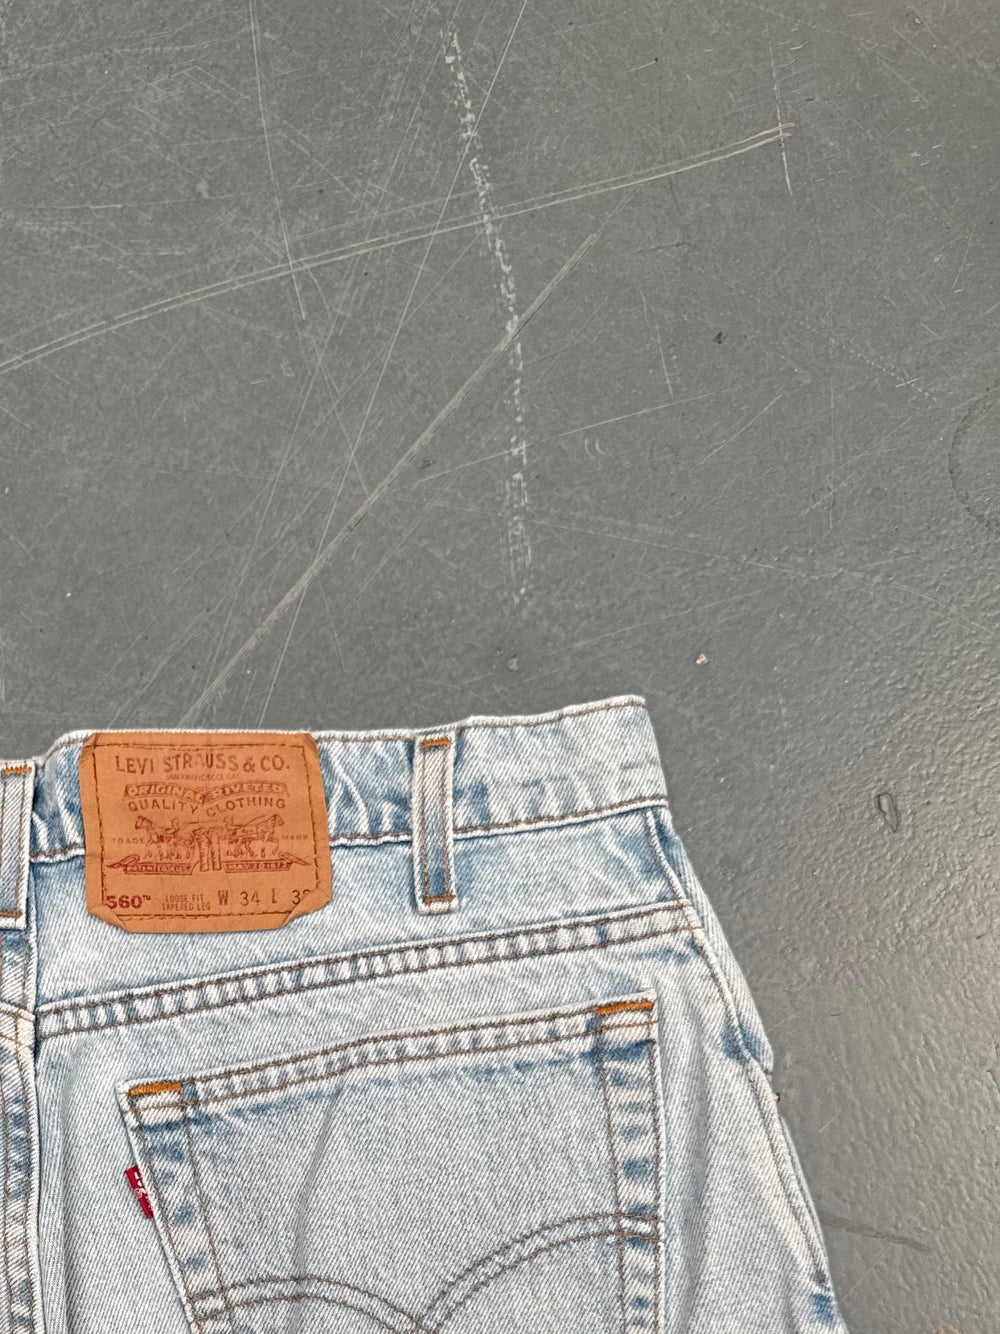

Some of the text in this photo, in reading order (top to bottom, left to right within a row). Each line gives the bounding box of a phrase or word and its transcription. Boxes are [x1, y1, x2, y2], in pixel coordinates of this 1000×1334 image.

[114, 755, 154, 774] LEVI
[243, 757, 256, 773] &
[260, 754, 291, 771] CO.
[210, 782, 284, 799] RIVETED
[127, 796, 287, 817] QUALITY CLOTHING
[111, 837, 145, 845] TRADE
[196, 902, 211, 911] LEG
[217, 890, 229, 905] W
[239, 890, 260, 907] 34
[271, 888, 277, 904] L
